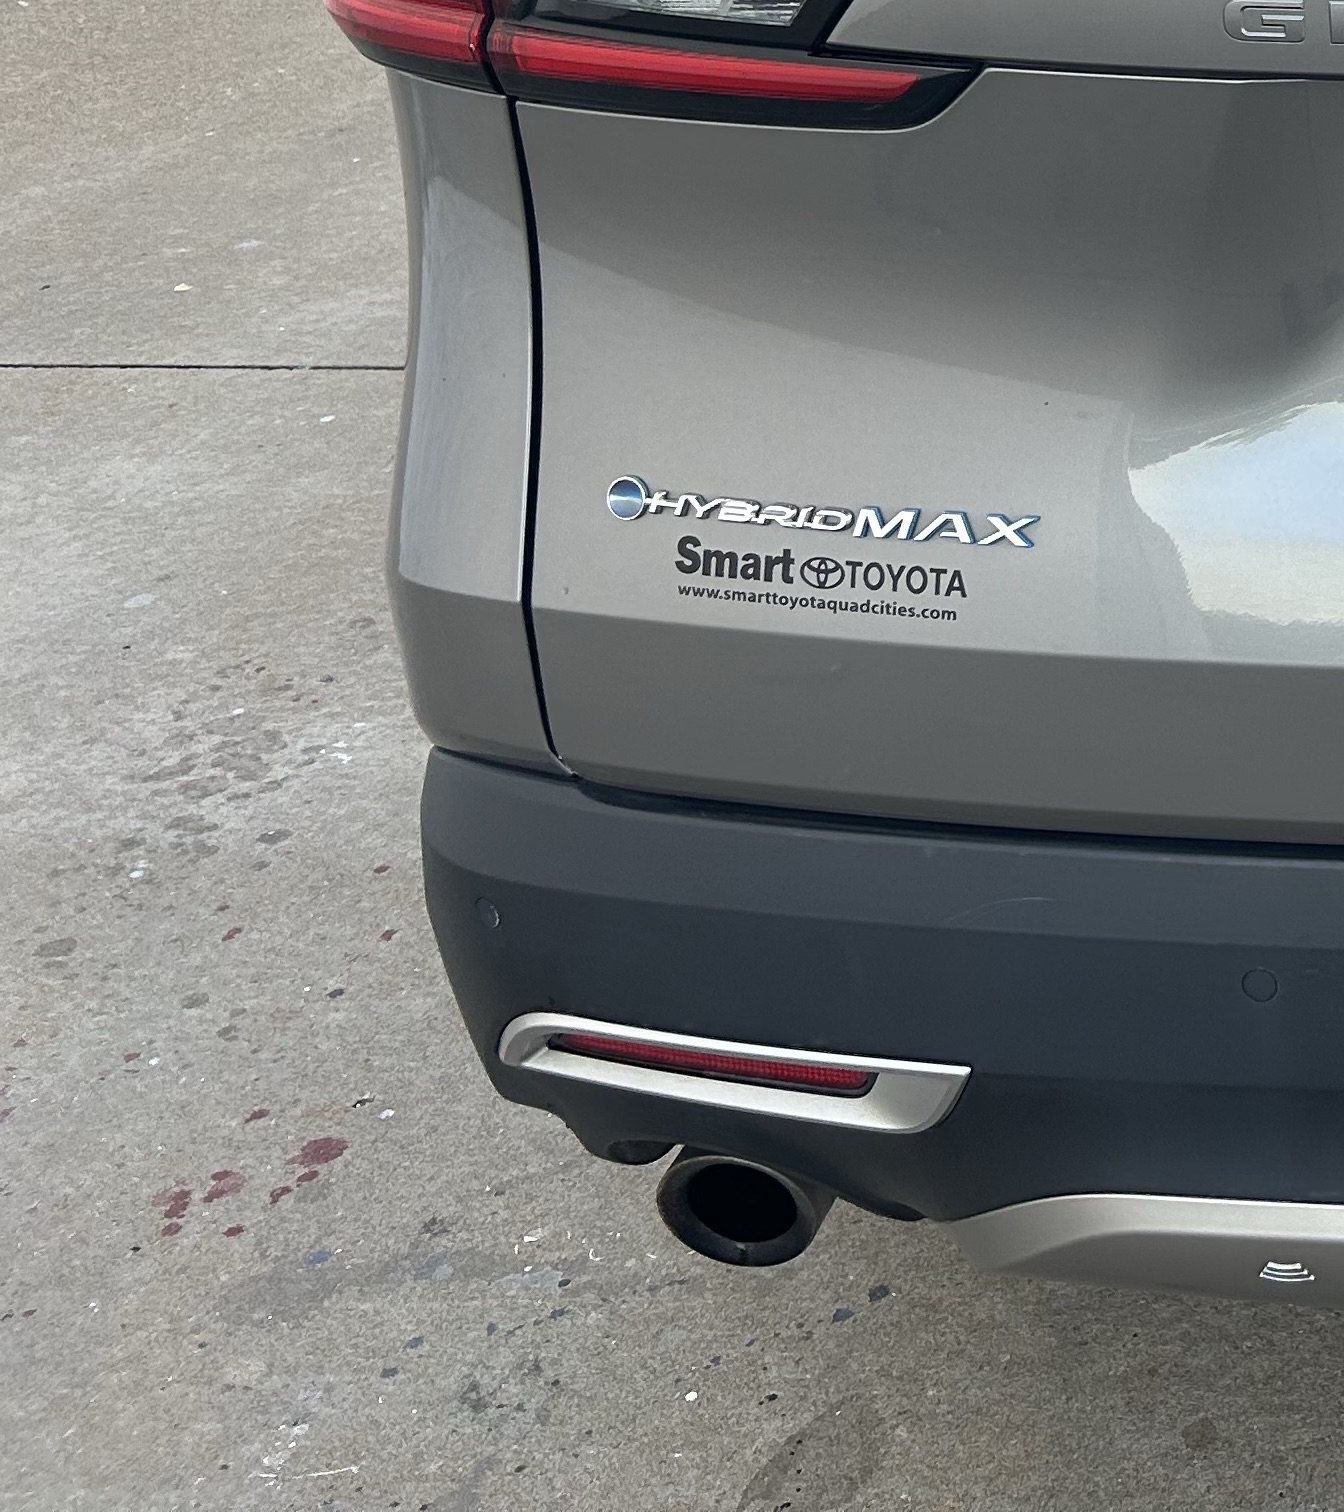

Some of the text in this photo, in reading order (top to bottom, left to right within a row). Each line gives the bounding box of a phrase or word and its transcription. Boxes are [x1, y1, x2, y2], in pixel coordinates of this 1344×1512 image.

[674, 535, 968, 598] Smart TOYOTA
[676, 584, 958, 622] www.smarttoyotaquadcities.com
